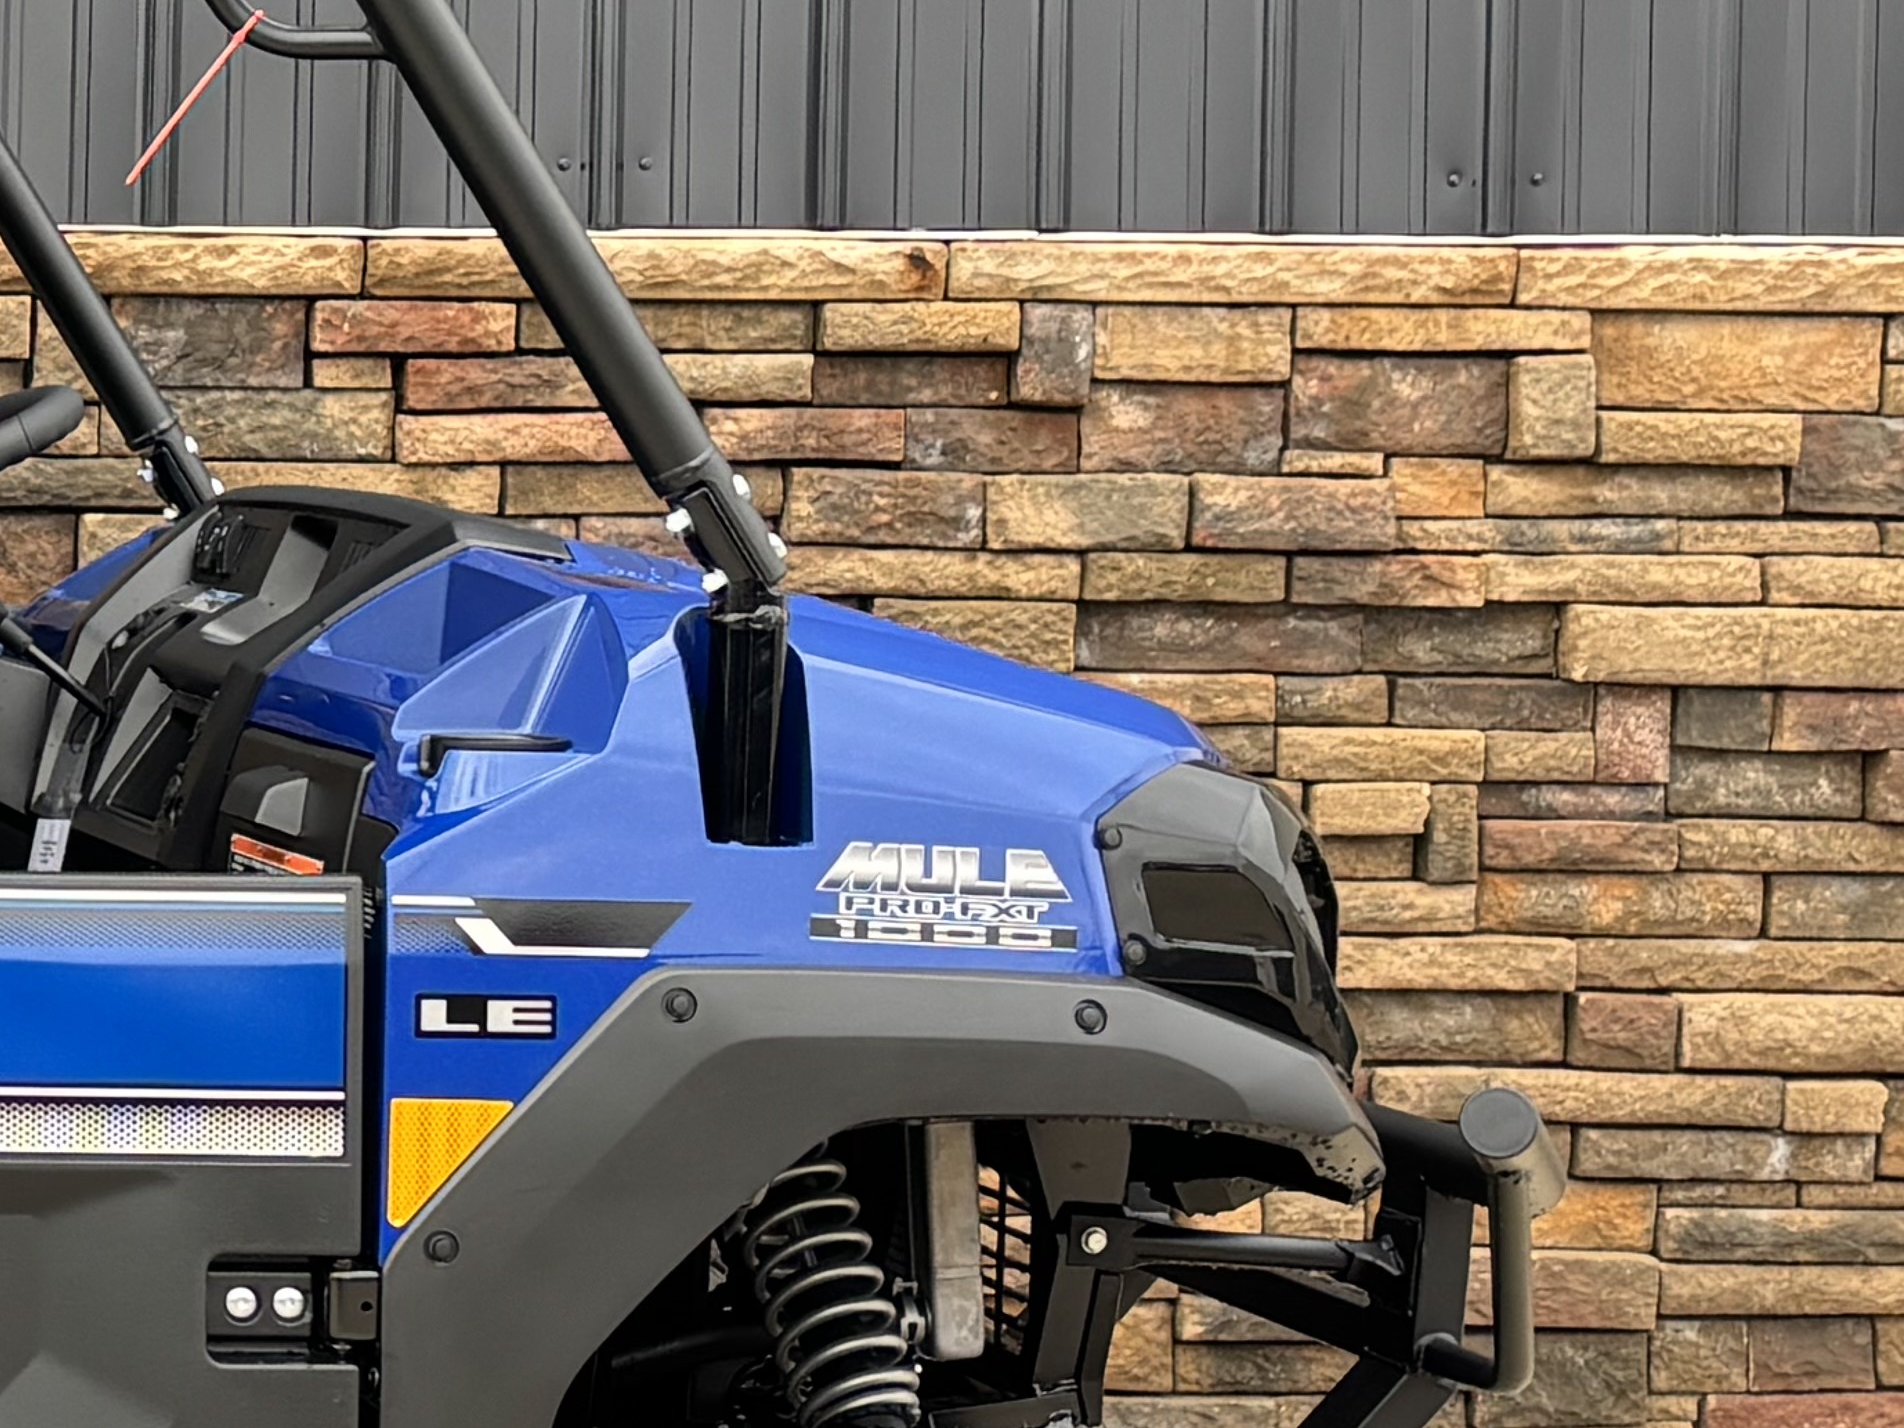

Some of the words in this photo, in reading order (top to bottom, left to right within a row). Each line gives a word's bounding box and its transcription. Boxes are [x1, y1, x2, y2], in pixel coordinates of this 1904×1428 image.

[816, 841, 1073, 902] MULE
[839, 892, 1049, 923] PRO-FXT
[835, 919, 1052, 947] 1000
[420, 999, 554, 1034] LE
